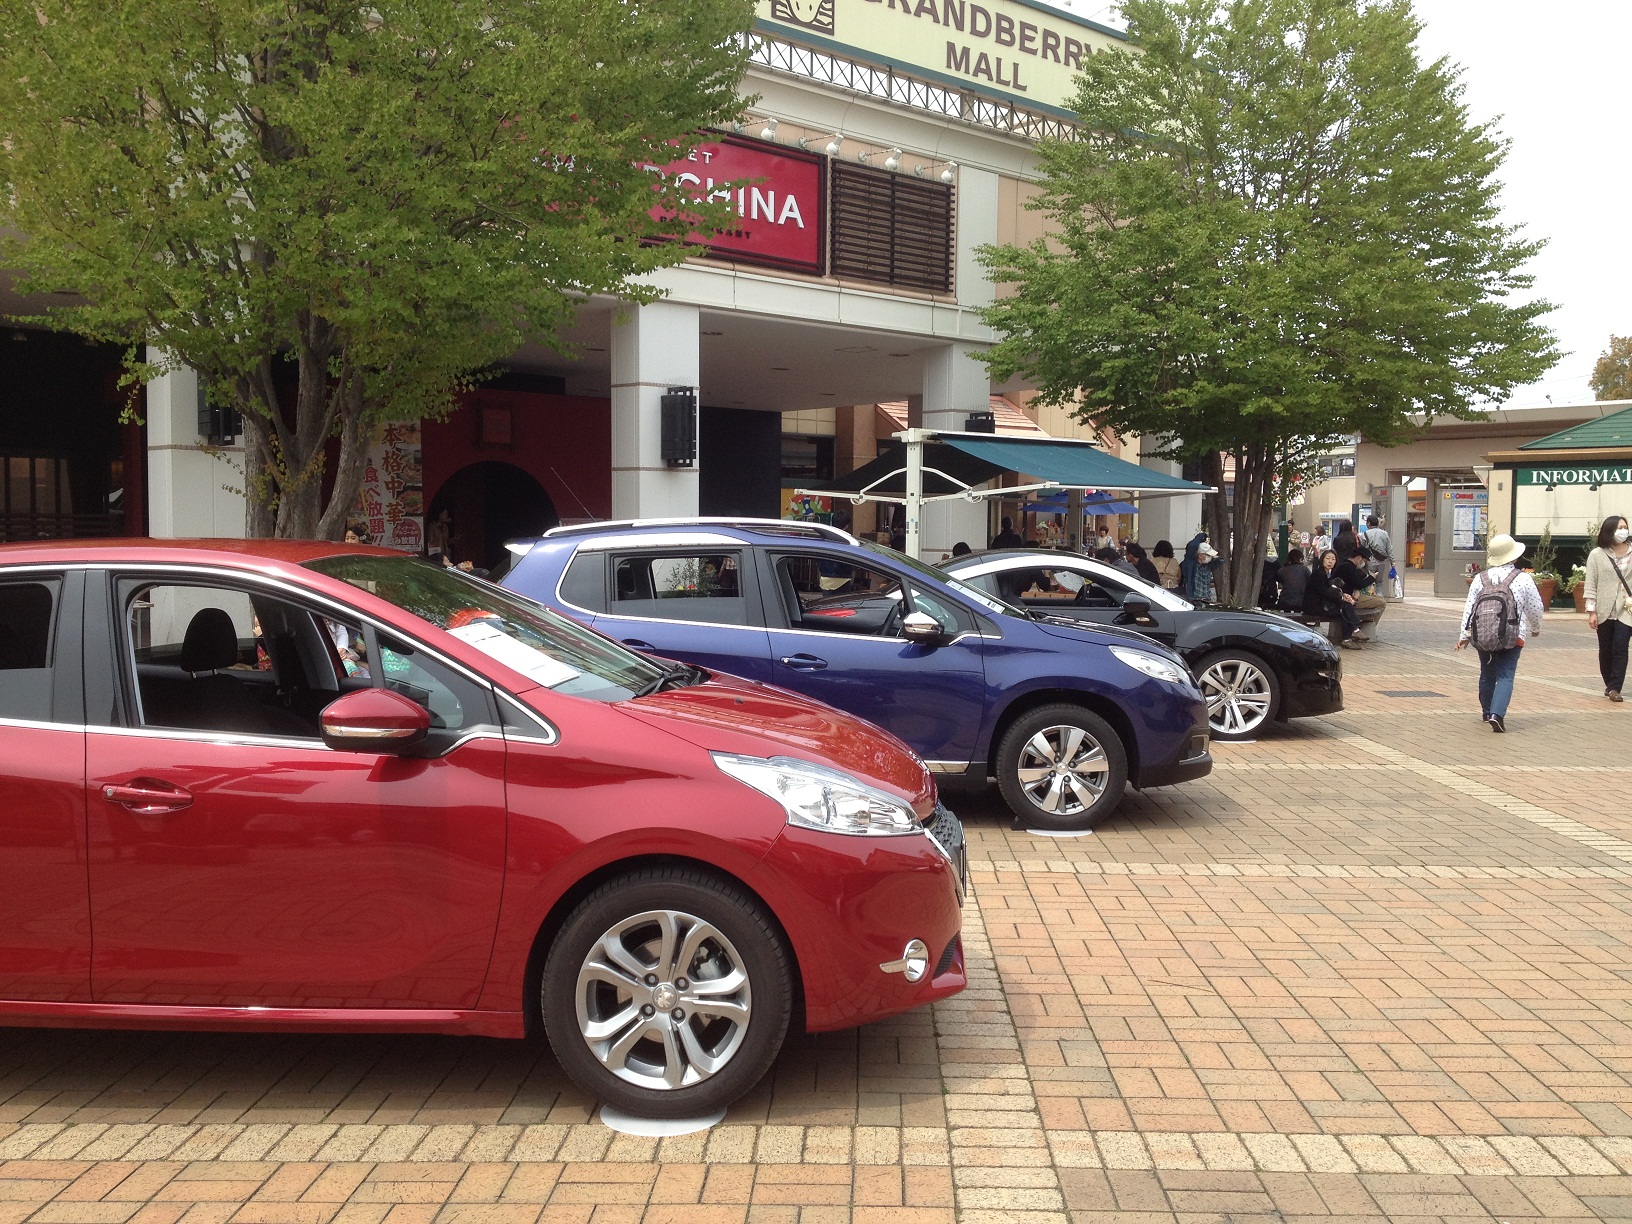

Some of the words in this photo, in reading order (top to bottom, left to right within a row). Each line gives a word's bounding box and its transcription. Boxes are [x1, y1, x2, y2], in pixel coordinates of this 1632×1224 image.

[864, 0, 1105, 71] ANDBERR
[946, 41, 1027, 91] MALL
[381, 422, 405, 527] 本格中華
